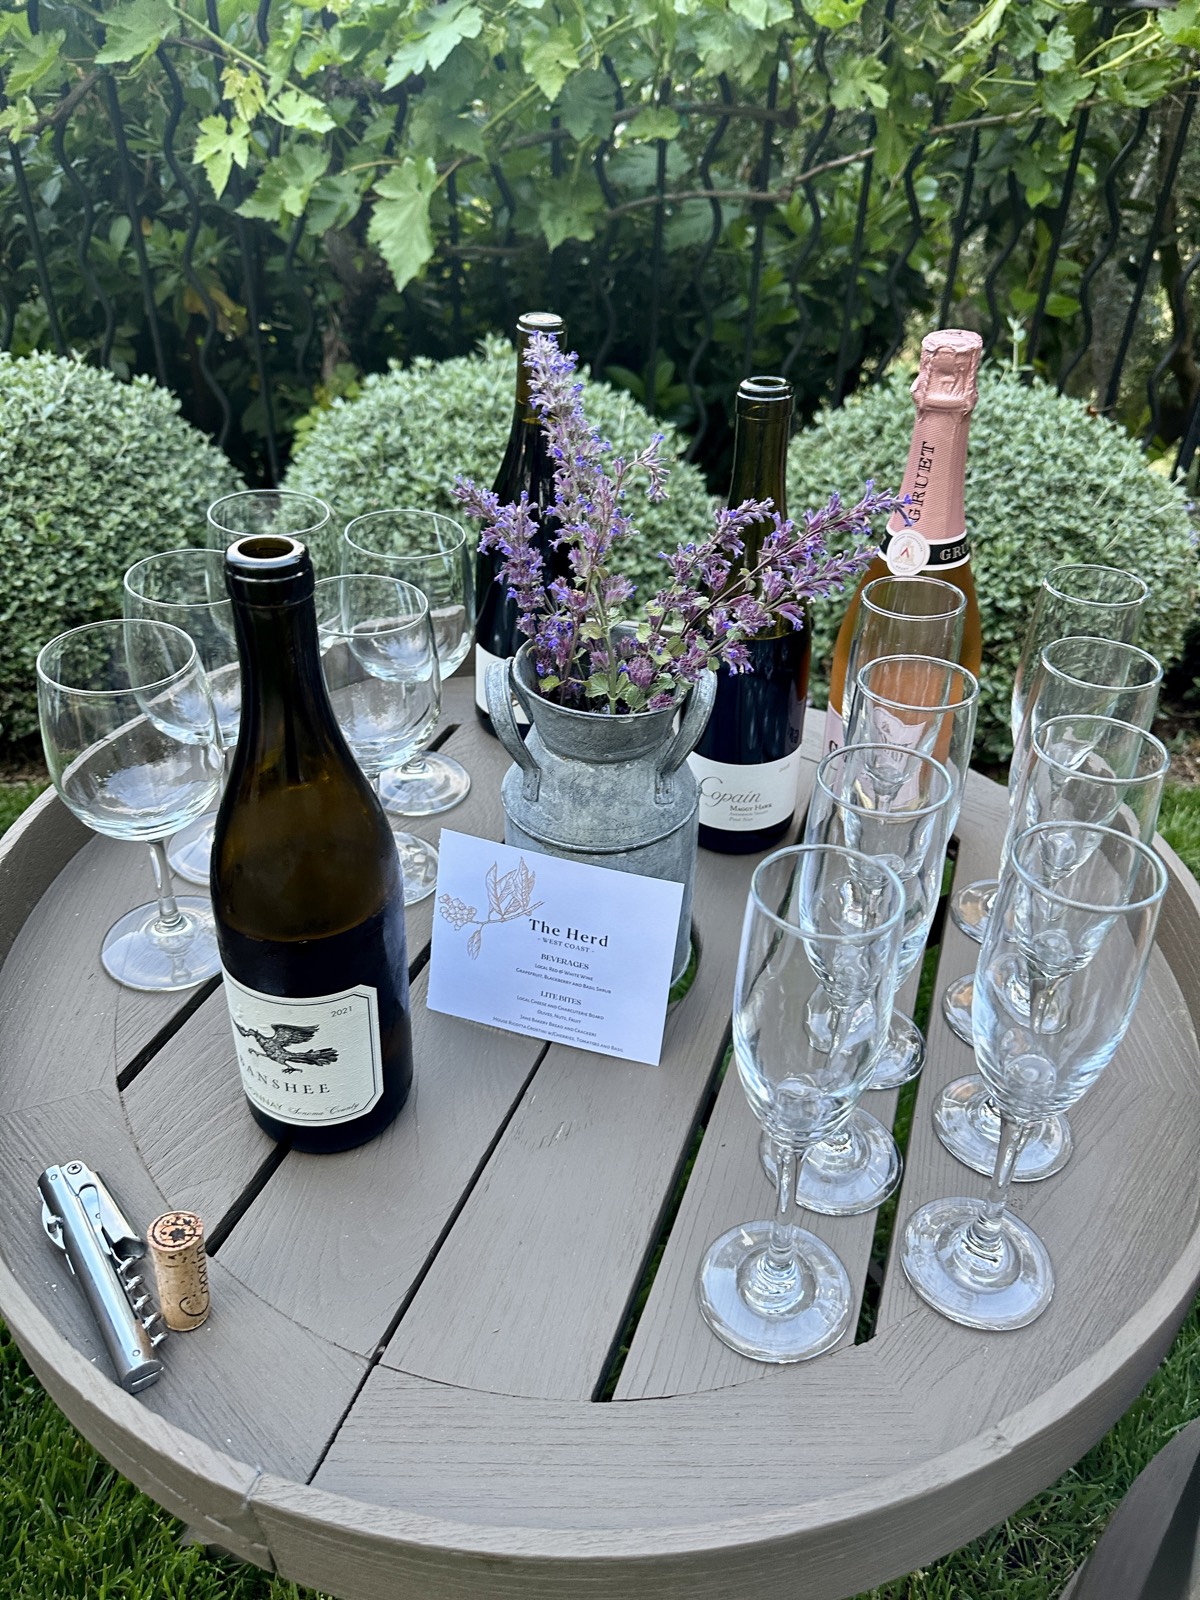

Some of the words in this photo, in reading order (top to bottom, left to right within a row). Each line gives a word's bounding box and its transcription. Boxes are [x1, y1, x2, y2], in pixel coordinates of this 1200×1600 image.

[908, 441, 935, 523] GRUET
[699, 776, 762, 808] Copain
[529, 918, 560, 936] The
[566, 927, 608, 947] Herd
[542, 937, 562, 946] WEST
[564, 942, 590, 953] COAST
[541, 953, 590, 970] BEVERAGES
[540, 990, 558, 1000] LITE
[559, 995, 581, 1005] BITES
[330, 1005, 352, 1018] 2021
[289, 1106, 325, 1116] Sonoma
[325, 1103, 360, 1115] County
